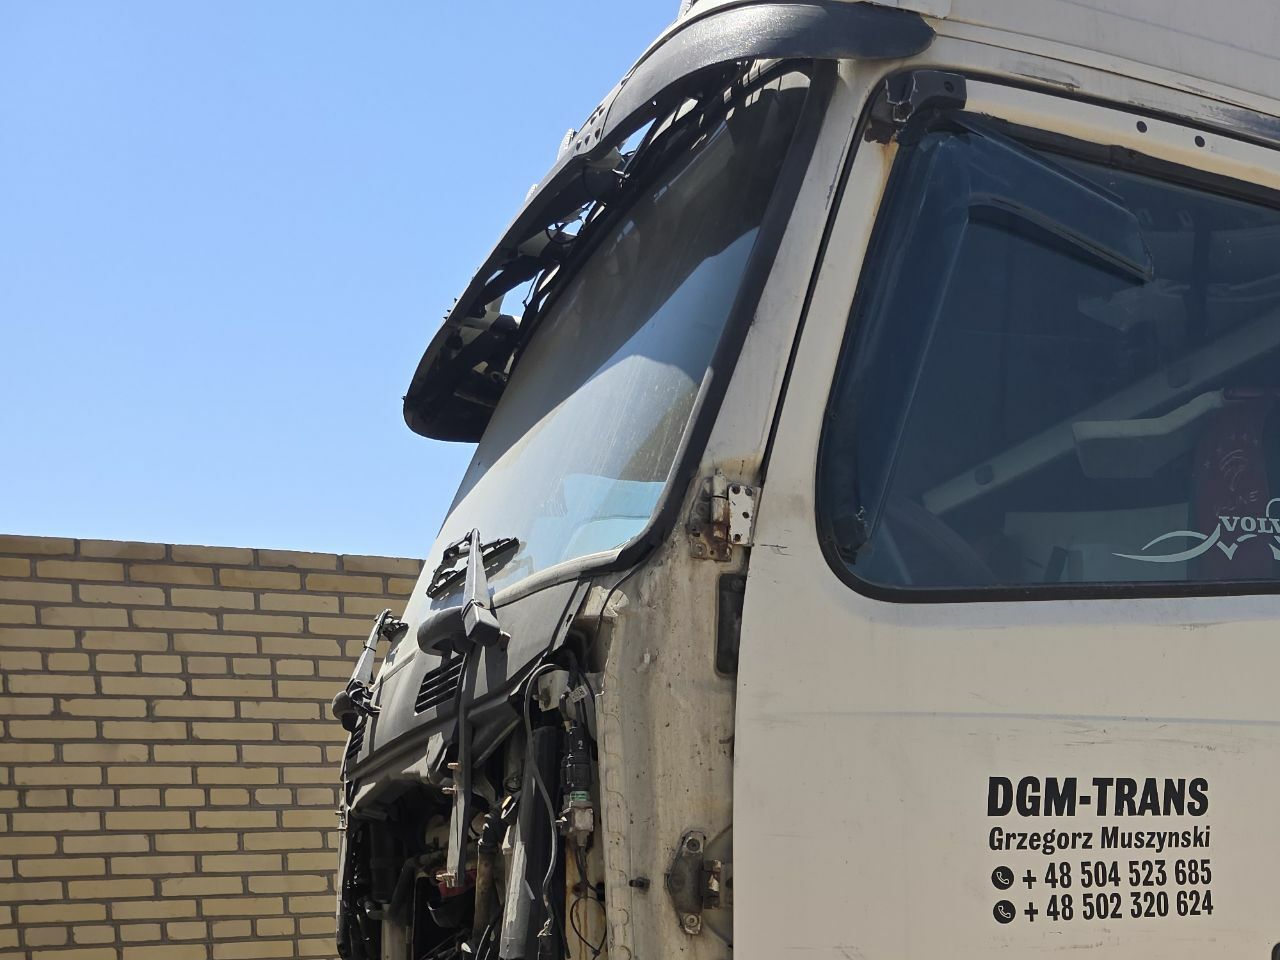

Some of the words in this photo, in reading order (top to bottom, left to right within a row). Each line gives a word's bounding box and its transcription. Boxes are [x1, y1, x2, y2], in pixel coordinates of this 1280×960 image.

[987, 776, 1209, 817] DGM-TRANS
[988, 826, 1093, 855] Grzegorz
[1100, 825, 1211, 853] Muszynski
[1022, 869, 1037, 889] +
[1044, 861, 1072, 888] 48
[1080, 861, 1121, 888] 504
[1128, 859, 1167, 886] 523
[1174, 859, 1212, 885] 685
[1024, 901, 1039, 922] +
[1046, 893, 1074, 921] 48
[1082, 893, 1122, 920] 502
[1130, 891, 1169, 917] 320
[1176, 889, 1213, 916] 624
